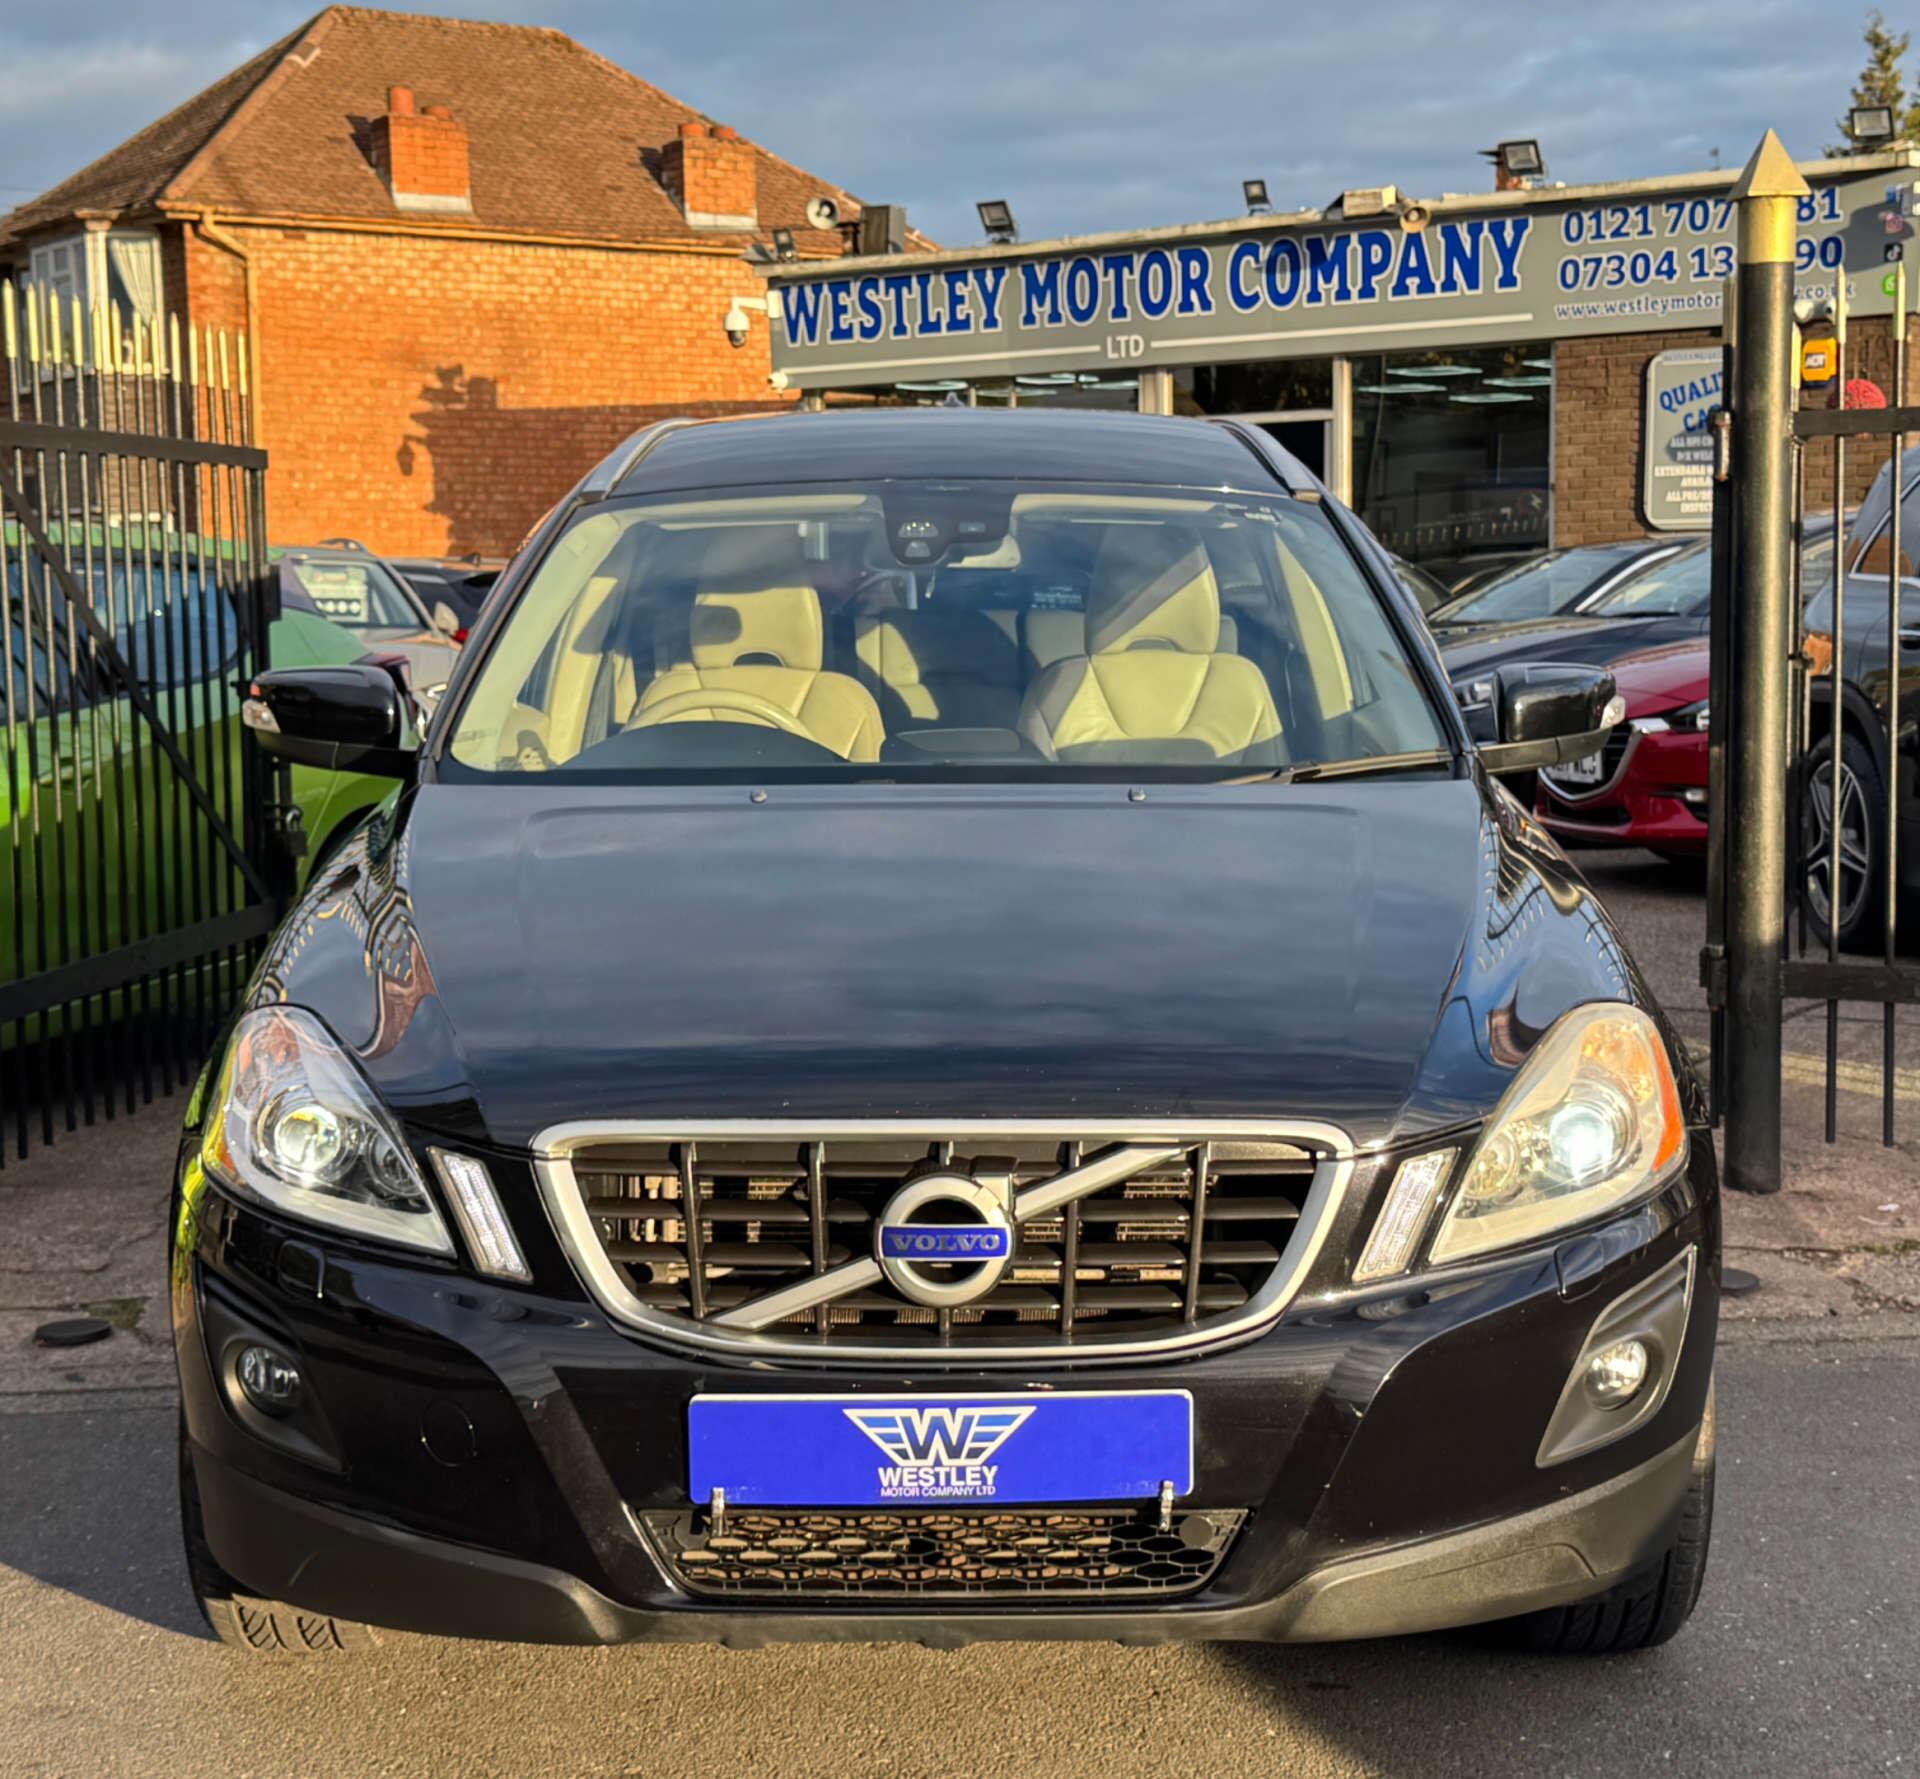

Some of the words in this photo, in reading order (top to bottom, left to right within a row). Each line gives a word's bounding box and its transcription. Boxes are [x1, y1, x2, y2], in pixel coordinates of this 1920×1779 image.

[1563, 205, 1654, 244] 0121
[1664, 199, 1734, 235] 707
[1797, 186, 1840, 223] 81
[1559, 252, 1678, 290] 07304
[1690, 246, 1735, 279] 13
[1796, 236, 1843, 270] 90
[779, 266, 1007, 345] WESTLEY
[1019, 246, 1214, 328] MOTOR
[1228, 217, 1531, 312] COMPANY
[1105, 335, 1145, 359] LTD
[1659, 371, 1723, 414] QUALI
[889, 1234, 1001, 1251] VOLVO
[877, 1465, 998, 1487] WESTLEY
[880, 1486, 920, 1497] MOTOR
[921, 1486, 975, 1497] COMPANY
[976, 1484, 996, 1496] LTD
